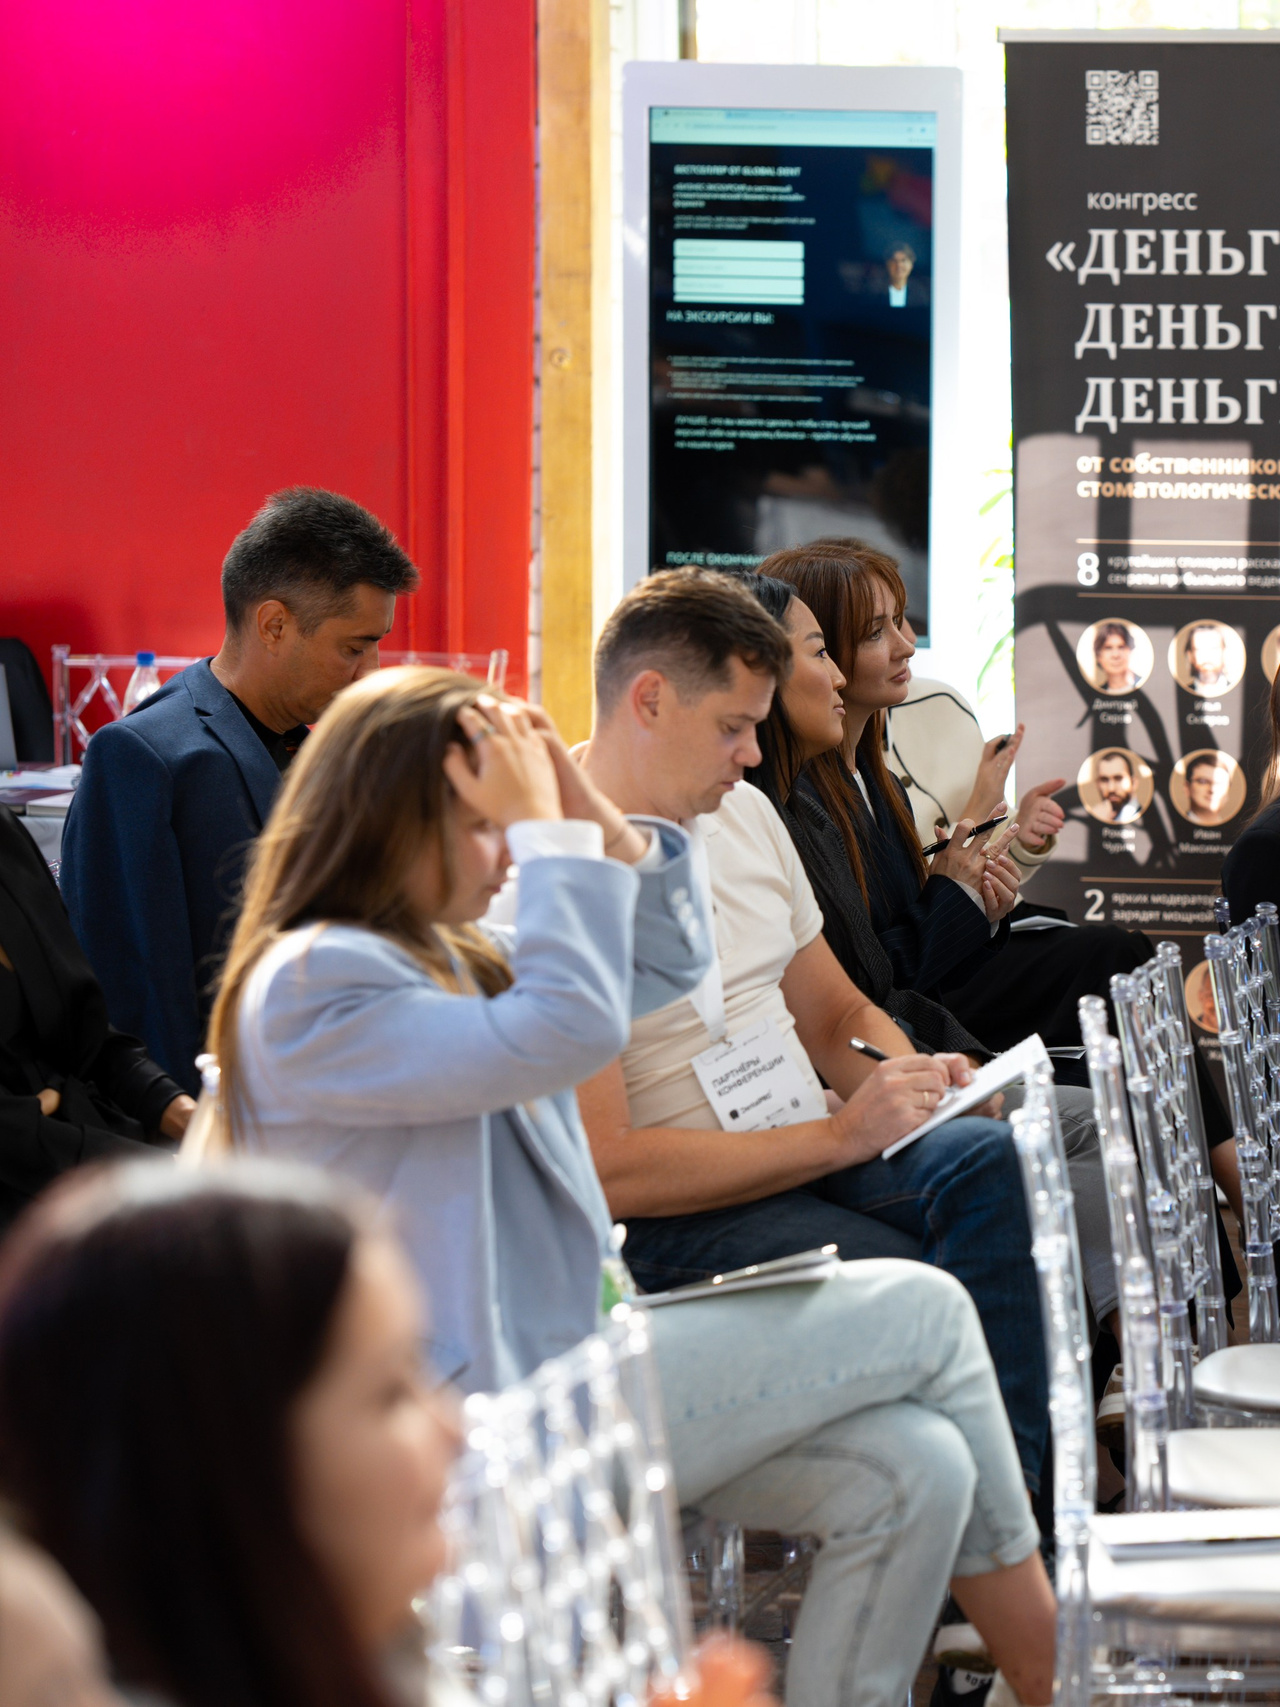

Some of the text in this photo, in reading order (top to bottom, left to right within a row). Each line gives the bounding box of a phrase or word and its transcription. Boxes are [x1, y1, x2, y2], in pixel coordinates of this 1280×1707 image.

[1087, 191, 1198, 216] конгресс
[1077, 455, 1104, 475] от
[1077, 551, 1100, 587] 8
[1084, 889, 1105, 921] 2
[1111, 892, 1216, 908] ярких модератор
[1111, 909, 1160, 924] зарядят
[711, 1056, 760, 1088] ПАРТНЁРЫ
[717, 1054, 786, 1097] КОНФЕРЕНЦИИ
